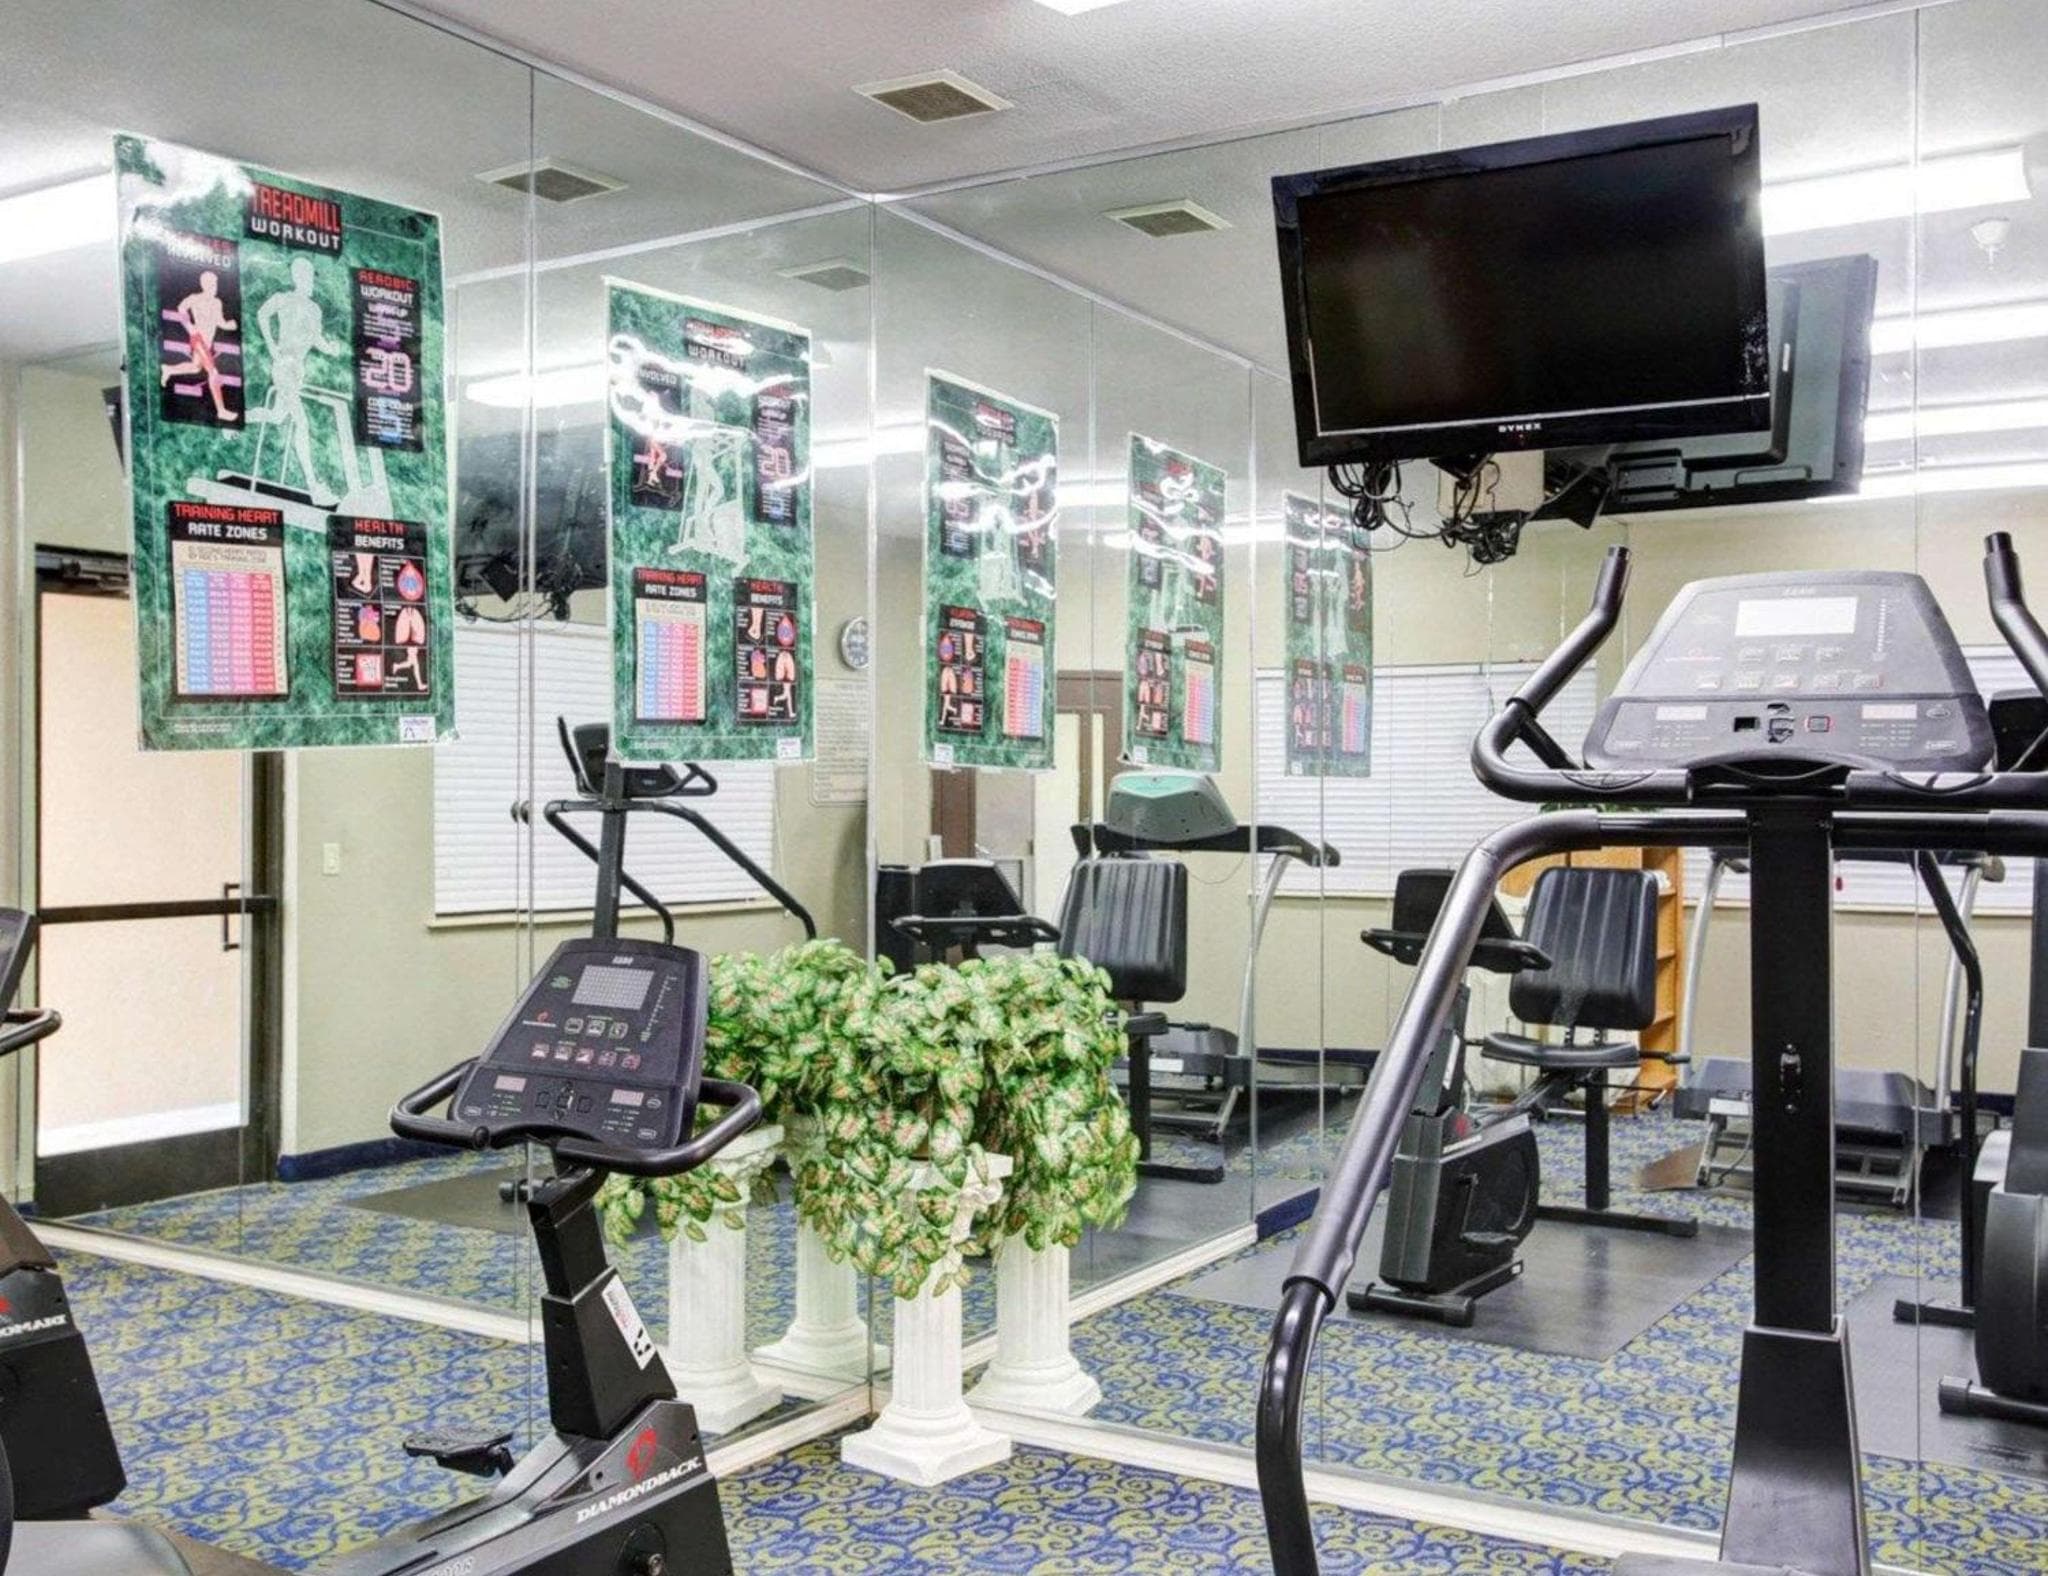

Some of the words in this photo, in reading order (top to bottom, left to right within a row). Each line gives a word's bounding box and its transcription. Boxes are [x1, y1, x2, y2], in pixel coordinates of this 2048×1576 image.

[251, 216, 341, 251] WORKOUT
[174, 503, 236, 521] TRAINING
[238, 509, 279, 524] HEART
[187, 521, 222, 537] RATE
[225, 524, 268, 541] ZONES
[354, 519, 405, 534] HEALTH
[354, 534, 405, 551] BENEFITS
[576, 1456, 702, 1524] DIAMONDBACK
